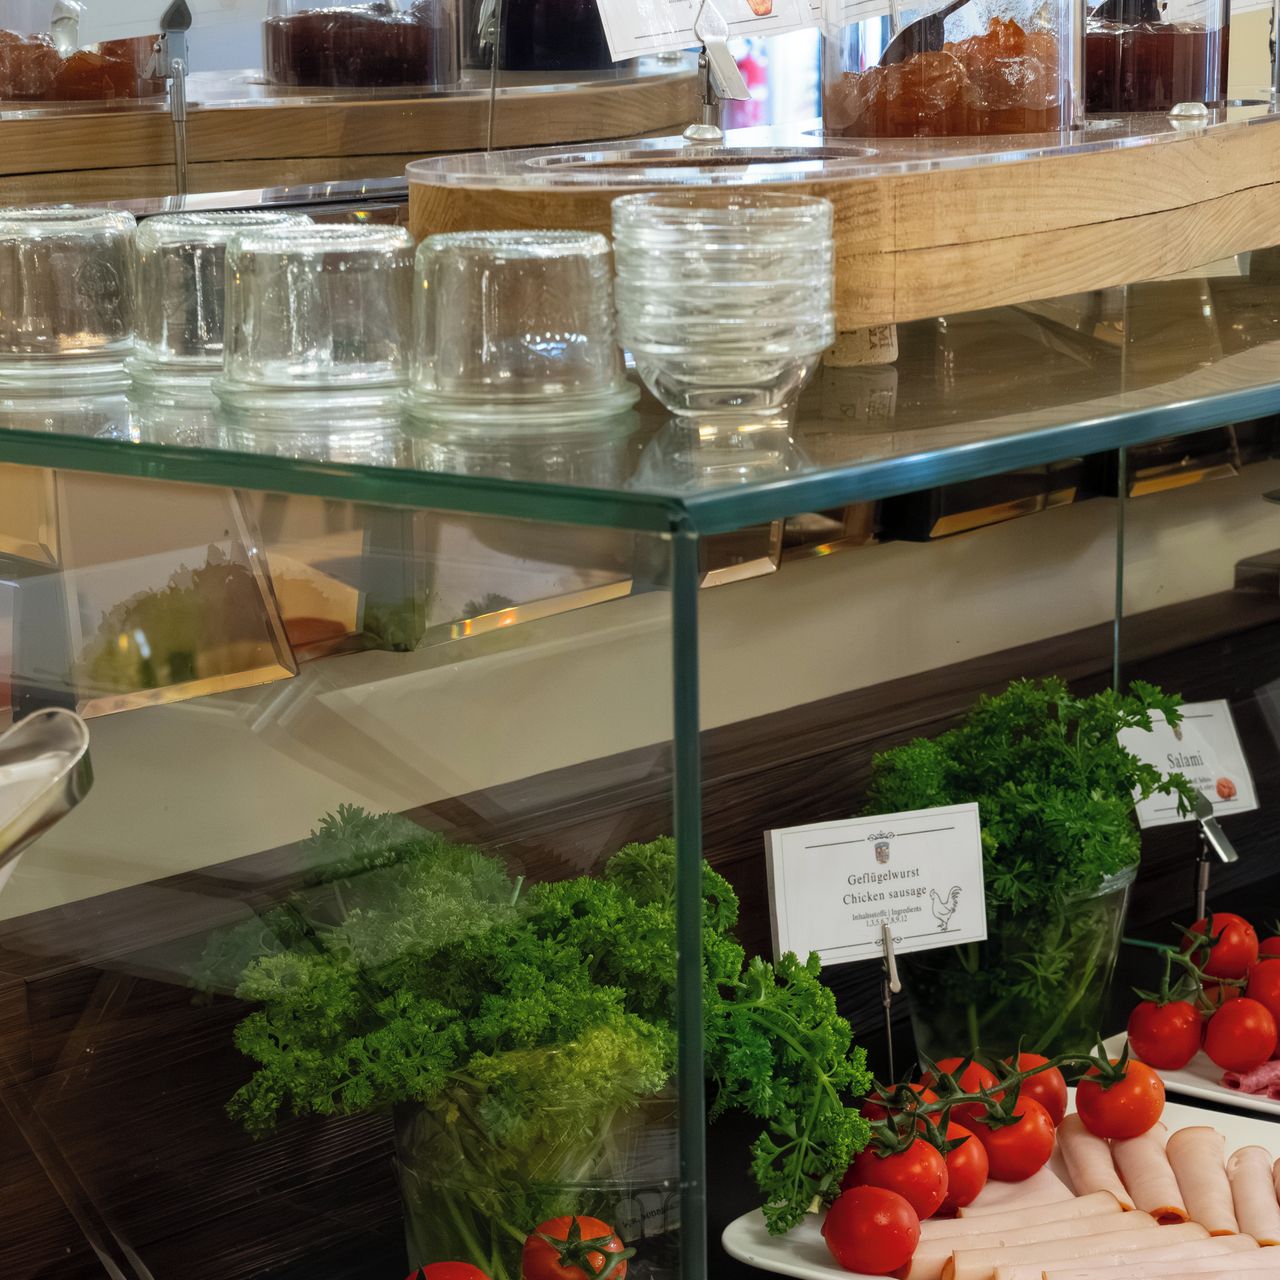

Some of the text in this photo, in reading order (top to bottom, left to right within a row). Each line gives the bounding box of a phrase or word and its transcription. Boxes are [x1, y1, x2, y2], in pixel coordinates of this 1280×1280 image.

[1167, 751, 1204, 769] Salami
[847, 868, 920, 886] Geflügelwurst
[843, 886, 927, 905] Chicken sausage
[852, 909, 887, 921] Inhaltsstoffe
[891, 906, 922, 916] Ingredients
